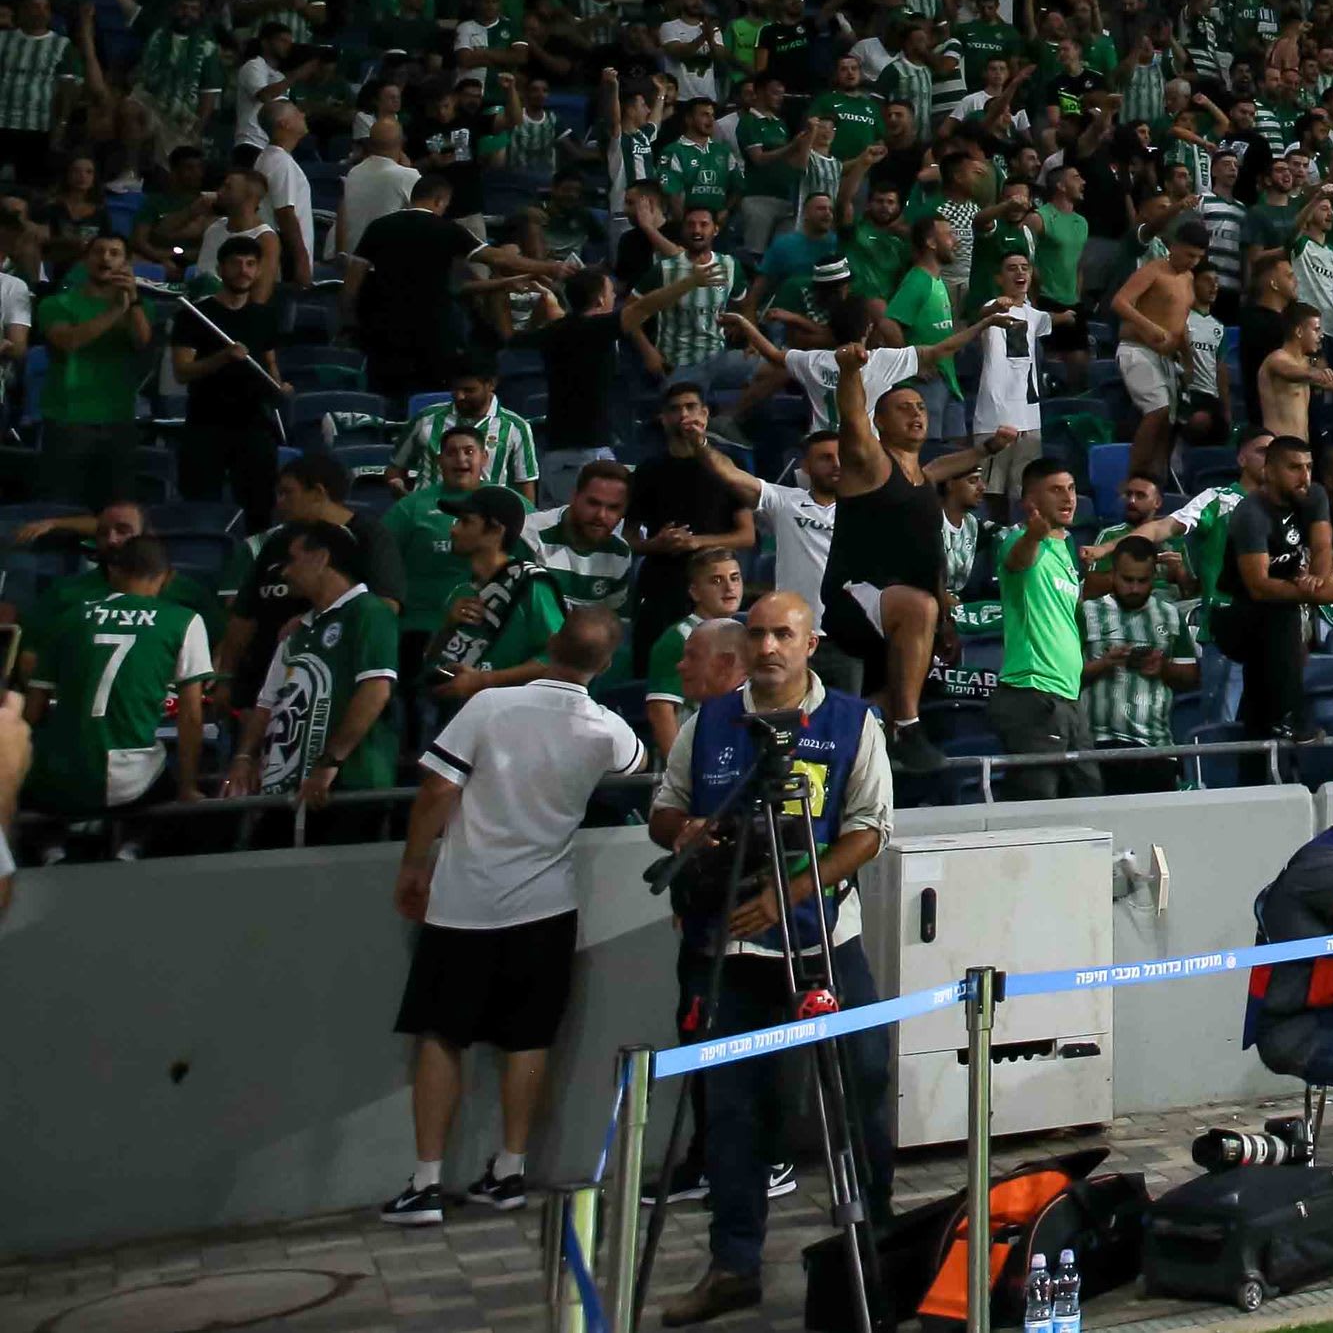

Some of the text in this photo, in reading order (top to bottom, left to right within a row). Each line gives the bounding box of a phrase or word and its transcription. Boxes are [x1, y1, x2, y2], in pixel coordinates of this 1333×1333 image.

[967, 41, 1003, 52] VOLVO
[838, 112, 875, 126] VOLVO
[85, 606, 158, 627] אצילי
[91, 633, 137, 718] 7
[927, 666, 999, 688] ACCAB
[1075, 953, 1222, 985] מועדון כדורגל מכבי חיפה
[700, 1022, 816, 1062] מועדון כדורגל מכבי חיפה
